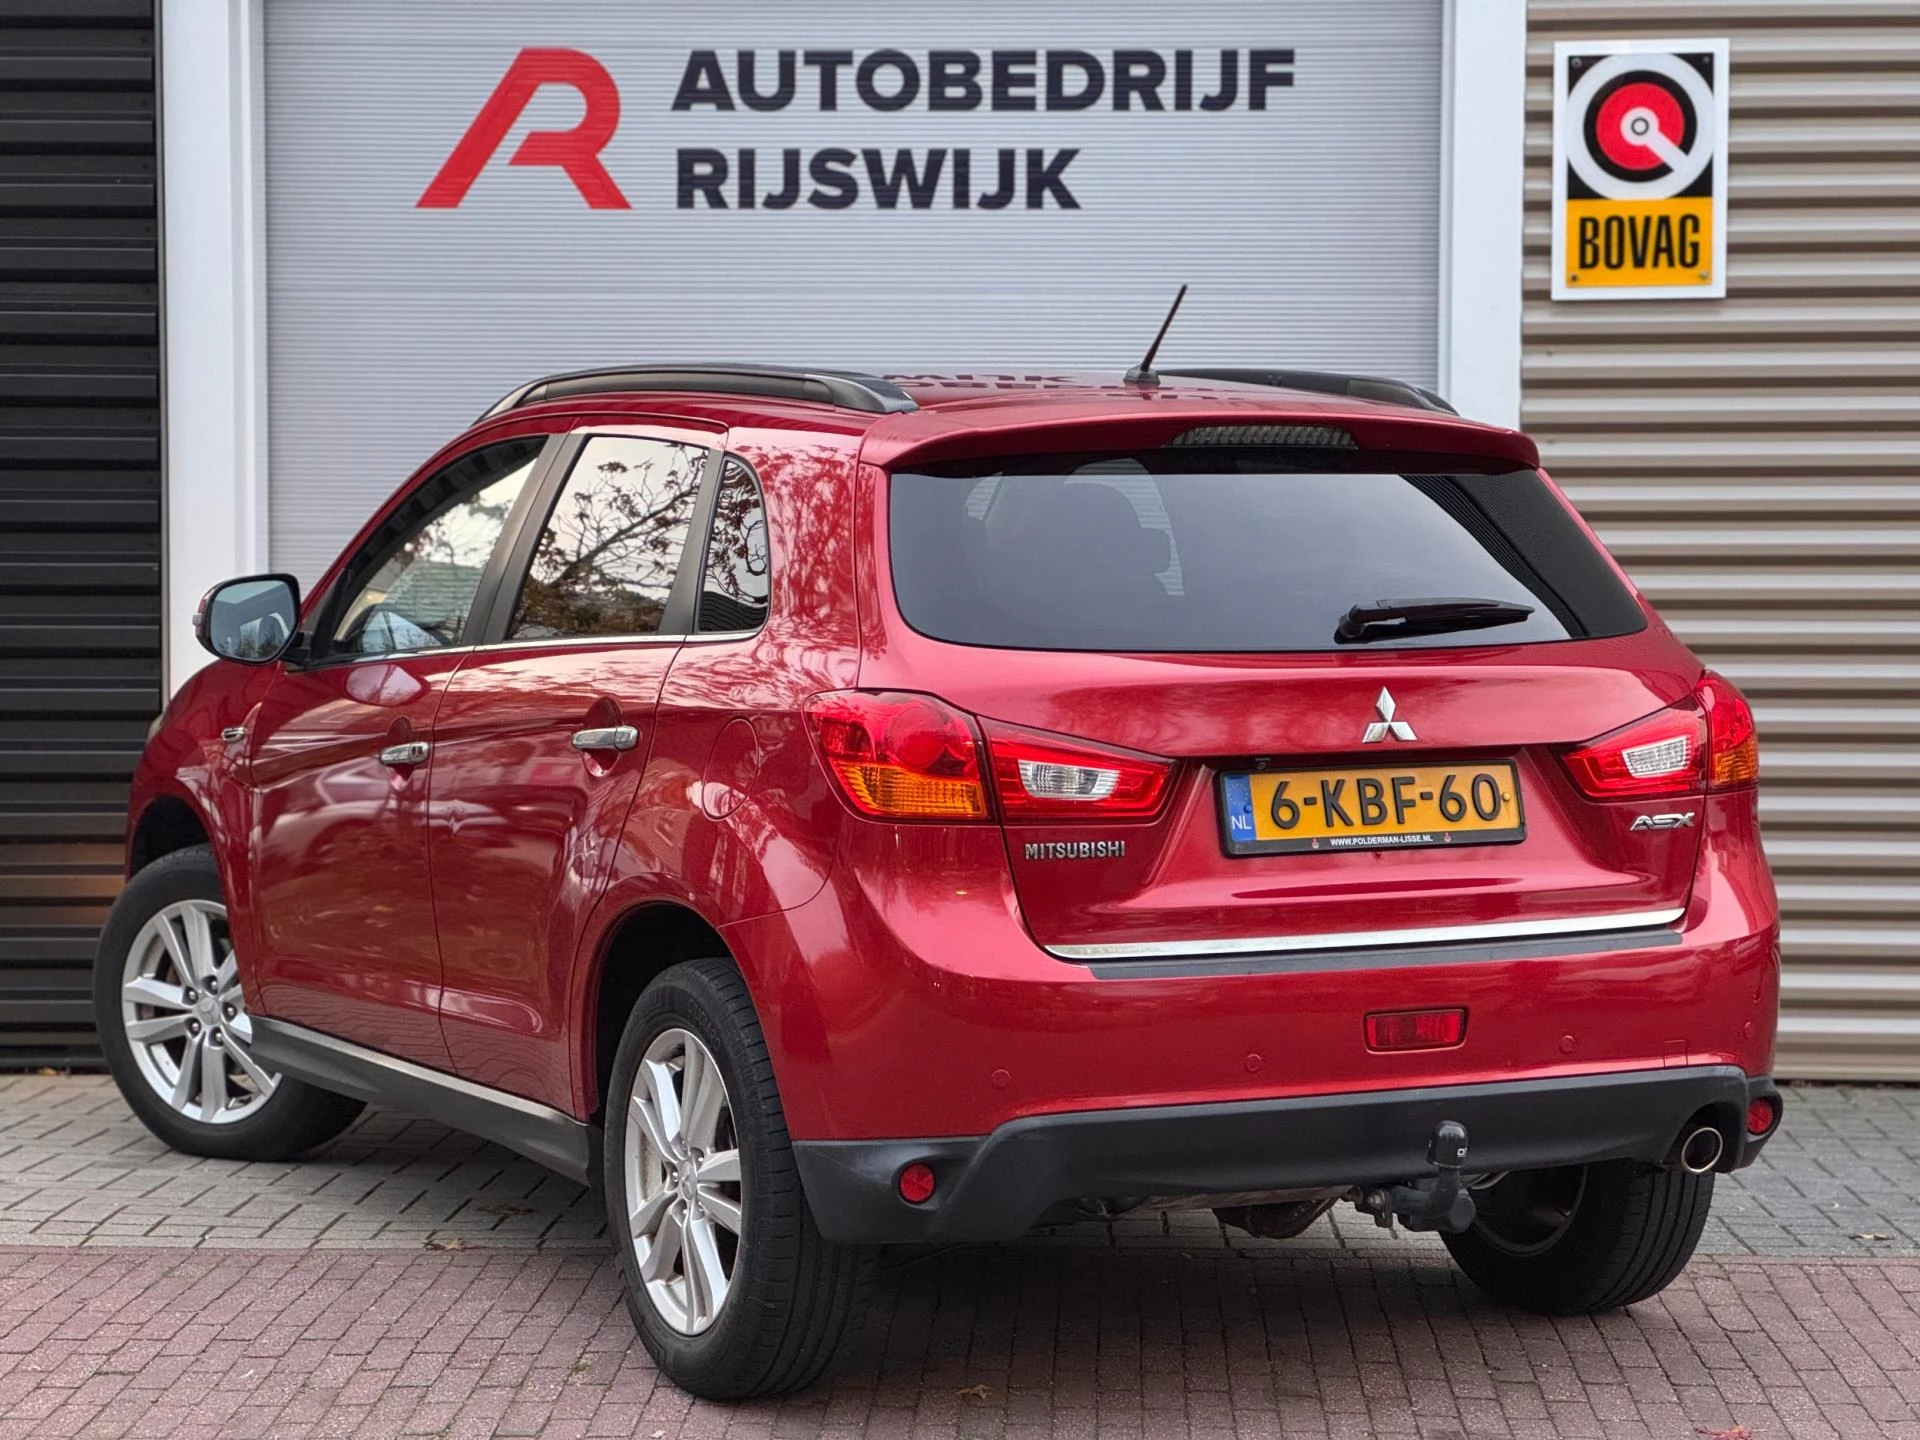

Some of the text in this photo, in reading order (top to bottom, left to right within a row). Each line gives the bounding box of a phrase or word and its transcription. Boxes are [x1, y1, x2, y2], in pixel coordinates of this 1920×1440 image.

[671, 48, 1296, 112] AUTOBEDRIJF
[676, 147, 1083, 210] RIJSWIJK
[1578, 213, 1700, 270] BOVAG
[1270, 772, 1502, 830] 6-KBF-60
[1231, 814, 1253, 831] NL
[1629, 811, 1696, 831] ASX
[1025, 840, 1126, 860] MITSUBISHI
[1330, 834, 1434, 847] WWW.POLDERMAN-LISSE.NL
